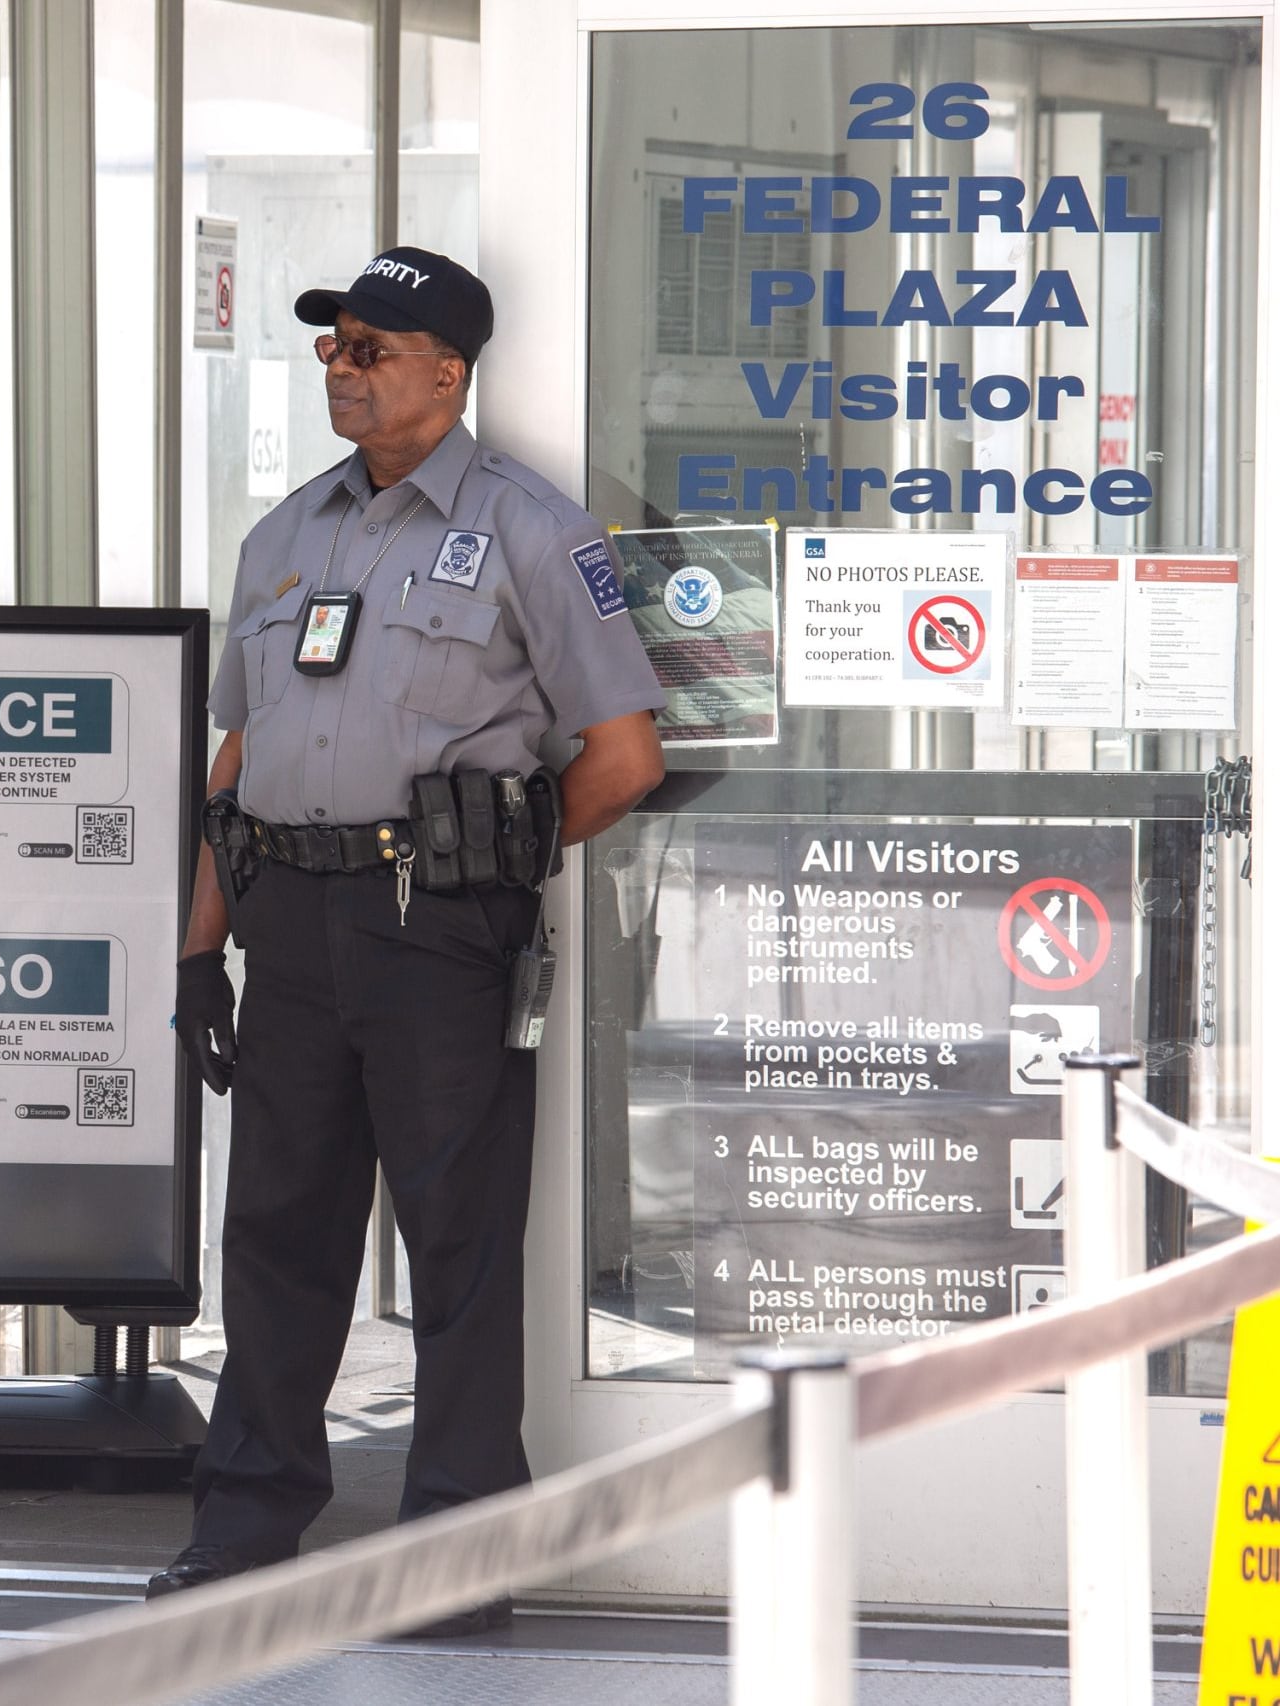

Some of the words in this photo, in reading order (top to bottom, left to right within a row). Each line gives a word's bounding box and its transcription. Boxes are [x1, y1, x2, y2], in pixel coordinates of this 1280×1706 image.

[847, 83, 990, 140] 26
[683, 176, 1160, 233] FEDERAL
[750, 270, 1088, 327] PLAZA
[741, 362, 1084, 421] Visitor
[252, 428, 284, 474] GSA
[678, 455, 1152, 516] Entrance
[806, 547, 825, 556] GSA
[807, 567, 832, 582] NO
[837, 566, 909, 582] PHOTOS
[914, 567, 984, 582] PLEASE.
[805, 599, 851, 613] Thank
[854, 605, 881, 616] you
[805, 624, 826, 637] for
[829, 628, 863, 639] your
[805, 649, 895, 663] cooperation.
[9, 757, 77, 768] DETECTED
[20, 772, 71, 783] SYSTEM
[33, 847, 53, 855] SCAN
[54, 847, 66, 855] ME
[801, 840, 853, 873] All
[866, 840, 1020, 874] Visitors
[714, 884, 726, 907] 1
[747, 884, 786, 907] No
[793, 884, 923, 913] Weapons
[932, 890, 963, 909] or
[746, 909, 897, 938] dangerous
[747, 935, 914, 959] instruments
[747, 961, 878, 988] permited.
[19, 1020, 36, 1030] EN
[40, 1021, 55, 1031] EL
[59, 1021, 114, 1032] SISTEMA
[713, 1014, 729, 1036] 2
[745, 1013, 857, 1038] Remove
[866, 1016, 898, 1039] all
[908, 1016, 984, 1040] items
[24, 1051, 109, 1062] NORMALIDAD
[743, 1039, 808, 1063] from
[818, 1041, 928, 1069] pockets
[936, 1042, 958, 1065] &
[745, 1065, 818, 1093] place
[828, 1066, 853, 1089] in
[861, 1068, 940, 1095] trays.
[713, 1135, 729, 1158] 3
[747, 1135, 804, 1158] ALL
[812, 1136, 880, 1165] bags
[888, 1138, 936, 1160] will
[945, 1139, 979, 1161] be
[748, 1161, 884, 1189] inspected
[893, 1164, 927, 1192] by
[747, 1187, 860, 1216] security
[868, 1189, 983, 1213] officers.
[713, 1259, 730, 1282] 4
[747, 1259, 805, 1282] ALL
[814, 1264, 927, 1288] persons
[936, 1265, 1008, 1288] must
[749, 1289, 815, 1312] pass
[824, 1288, 934, 1317] through
[943, 1290, 988, 1313] the
[748, 1311, 825, 1334] metal
